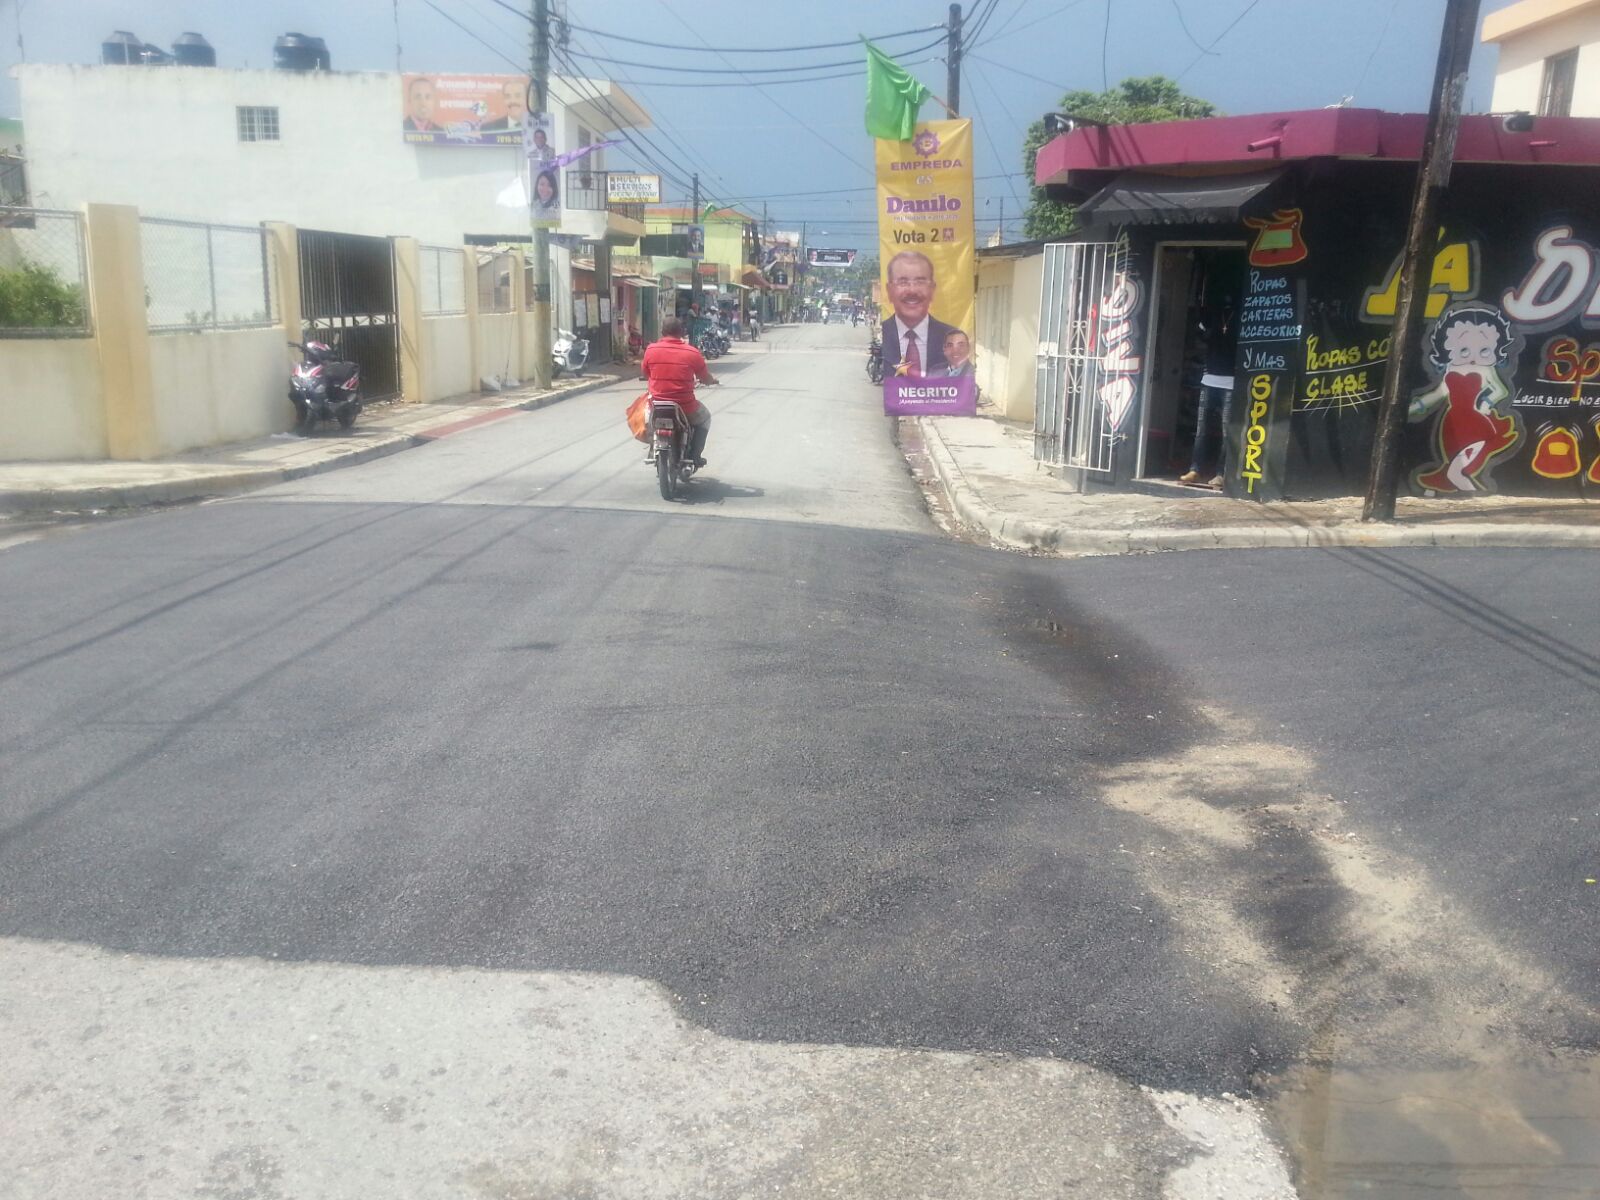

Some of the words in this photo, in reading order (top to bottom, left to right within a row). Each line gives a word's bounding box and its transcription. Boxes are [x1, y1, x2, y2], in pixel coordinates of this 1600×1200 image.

[890, 159, 963, 171] EMPREDA
[916, 175, 933, 185] es
[886, 194, 962, 214] Danilo
[893, 229, 926, 244] Vota
[930, 228, 940, 243] 2
[1244, 293, 1292, 308] ZAPATOS
[1240, 307, 1294, 323] CARTERAS
[1239, 324, 1302, 338] ACCESORIOS
[1306, 333, 1361, 372] ROPAS
[1366, 338, 1391, 360] CO
[898, 386, 958, 398] NEGRITO
[1512, 387, 1544, 404] LUCIR
[1545, 396, 1571, 406] BIEN
[1242, 374, 1272, 495] SPORT
